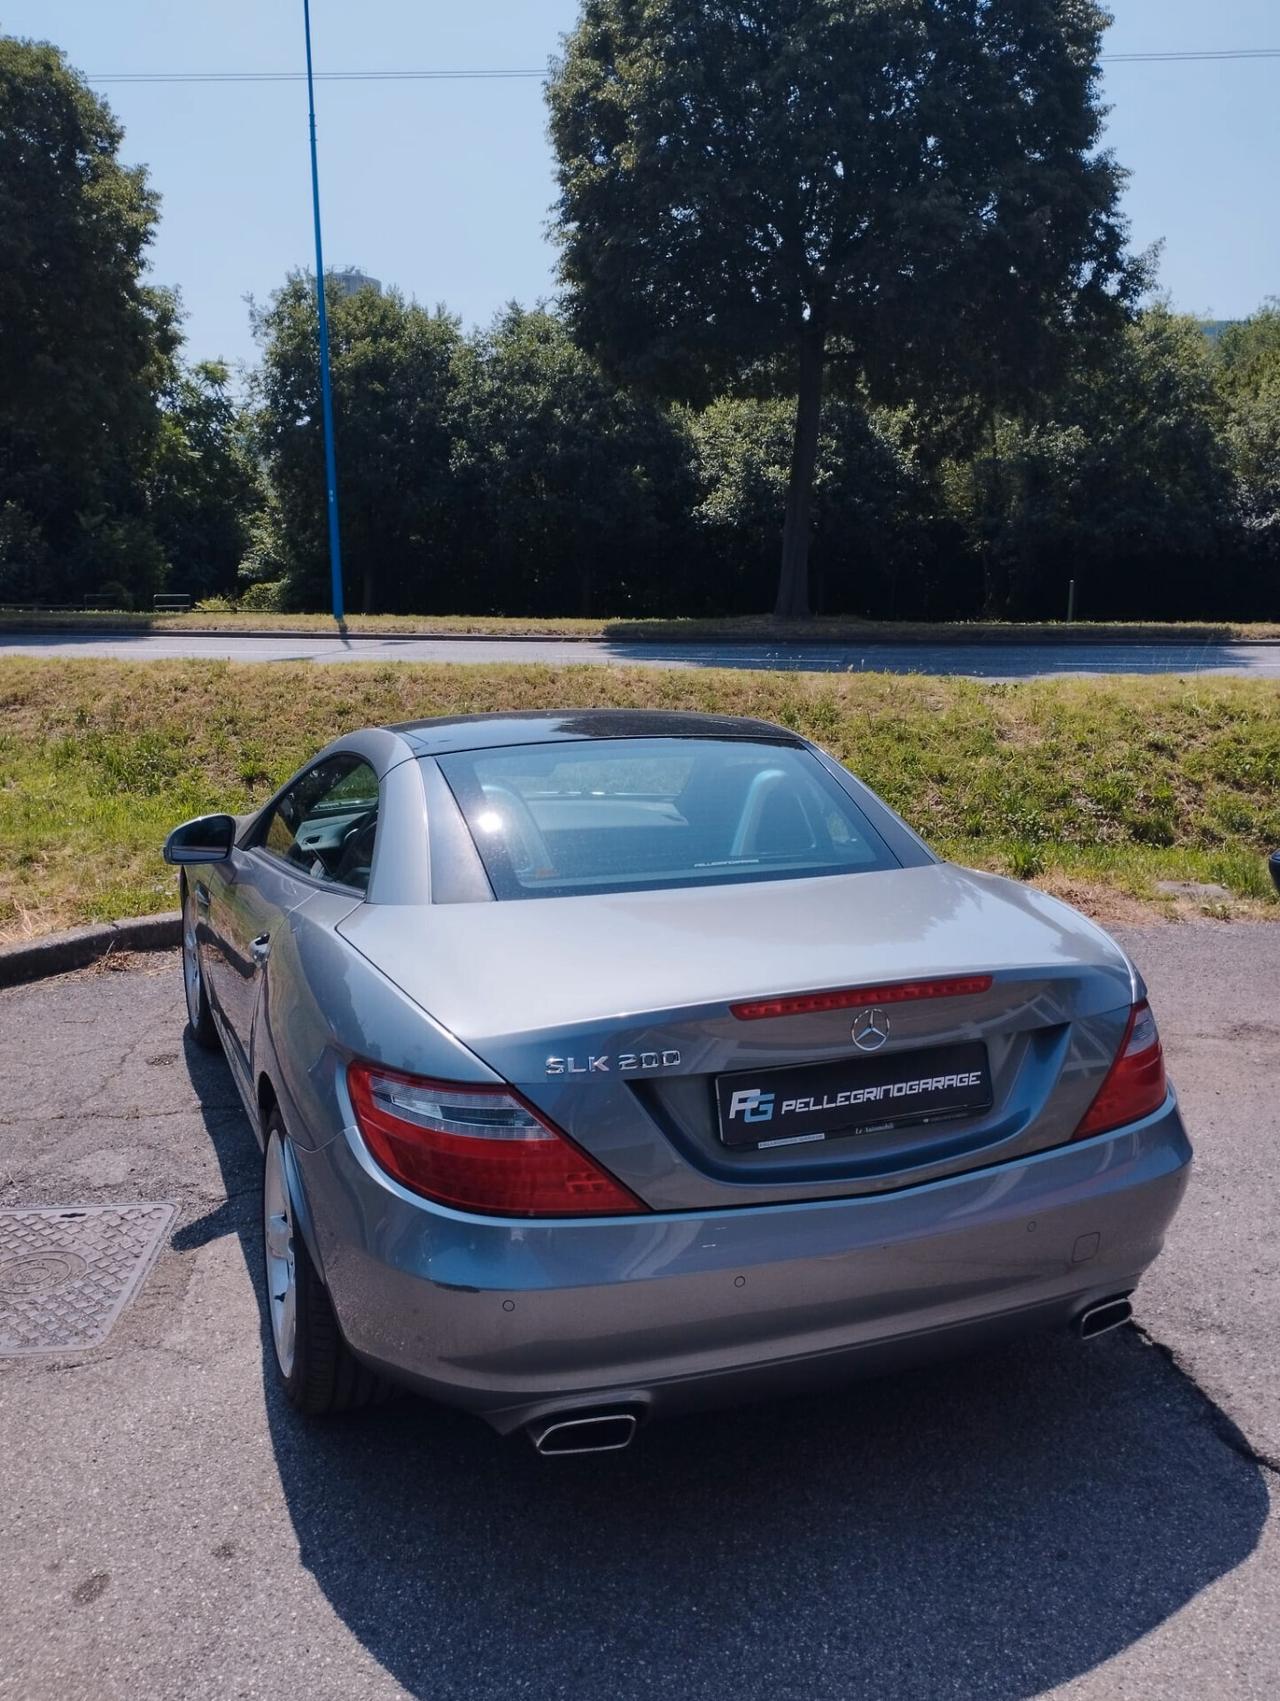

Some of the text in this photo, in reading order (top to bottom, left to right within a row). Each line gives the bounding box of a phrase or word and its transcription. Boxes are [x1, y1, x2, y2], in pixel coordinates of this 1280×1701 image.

[545, 1050, 681, 1075] SLK 200
[781, 1071, 982, 1115] PELLEGRINOGARAGE
